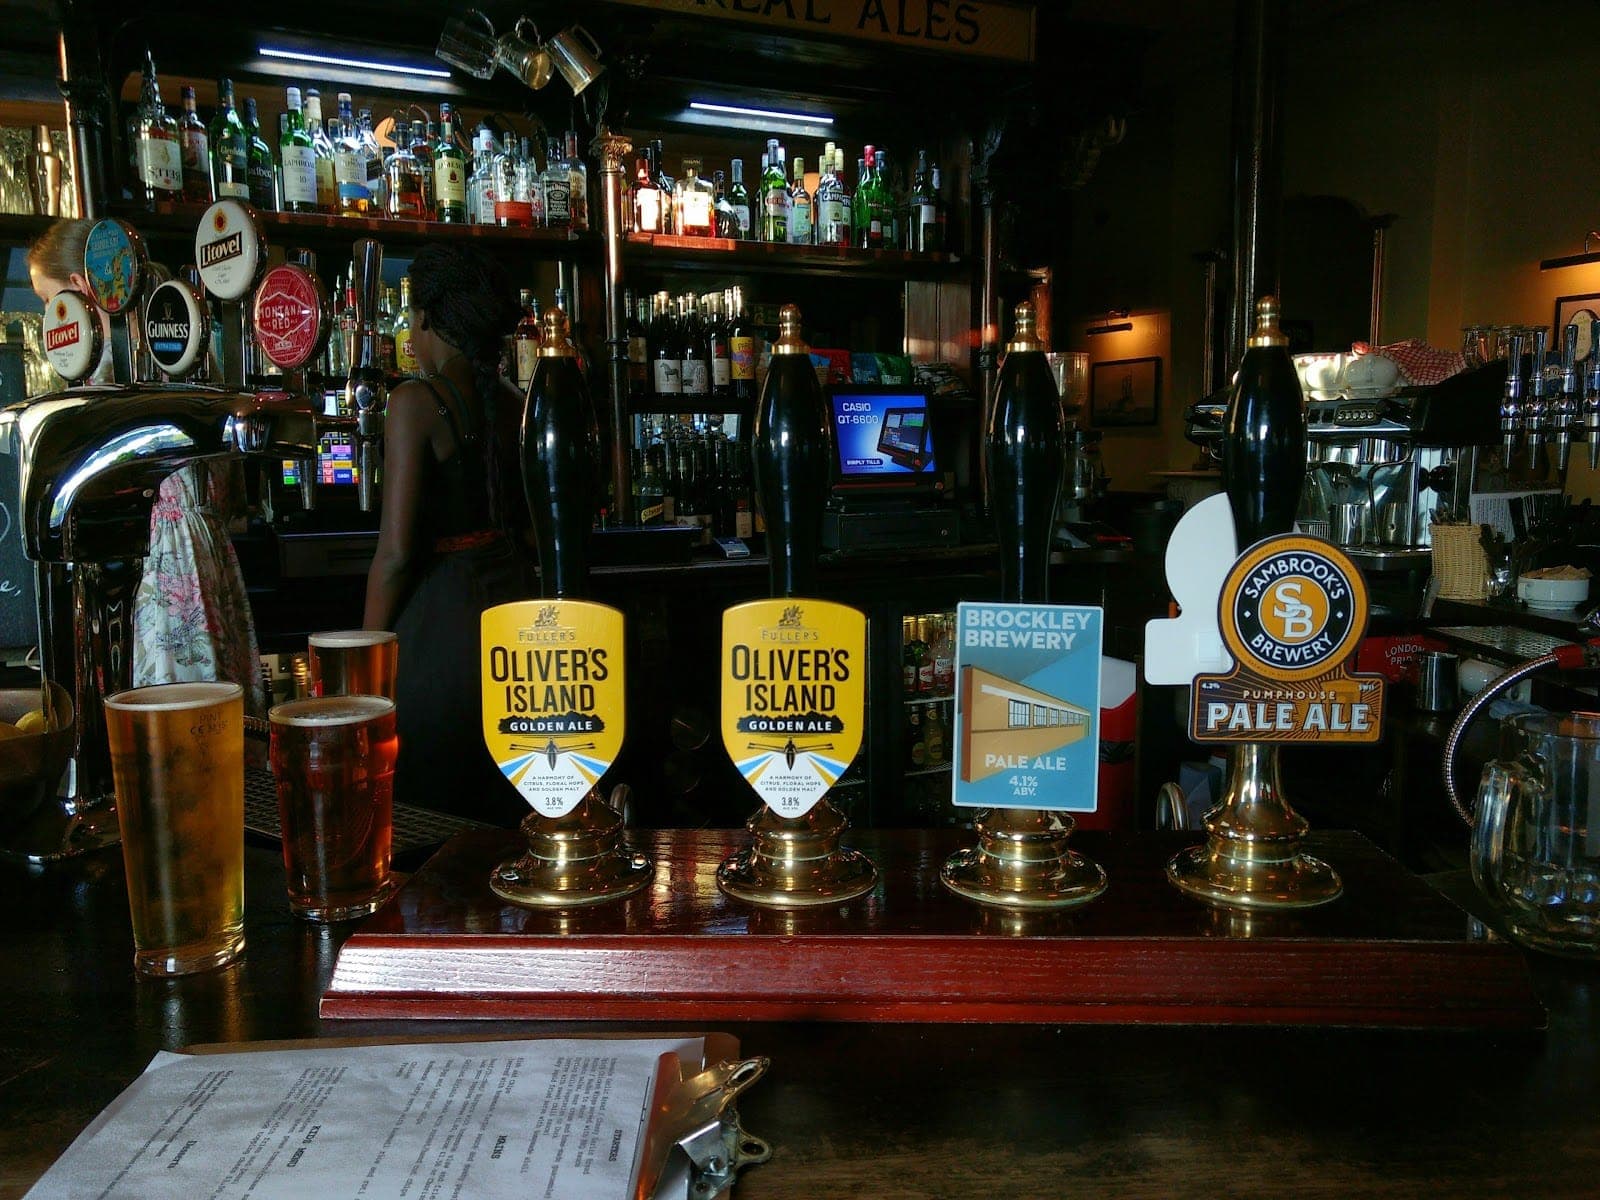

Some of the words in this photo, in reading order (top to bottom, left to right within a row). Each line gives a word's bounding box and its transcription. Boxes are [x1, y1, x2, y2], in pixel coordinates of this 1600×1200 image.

[857, 0, 981, 46] ALES
[201, 232, 241, 267] Litovel
[148, 320, 188, 338] GUINNESS
[271, 318, 291, 331] RED
[47, 322, 78, 350] Litovel
[842, 402, 871, 412] CASIO
[838, 415, 879, 425] QT-6600
[1245, 557, 1345, 599] SAMBROOK'S
[965, 609, 1091, 630] BROCKLEY
[964, 629, 1077, 650] BREWERY
[1251, 631, 1333, 662] BREWERY
[490, 646, 609, 683] OLIVER'S
[731, 644, 851, 683] OLIVER'S
[505, 684, 595, 713] ISLAND
[746, 684, 836, 712] ISLAND
[1243, 689, 1336, 700] PUMPHOUSE
[510, 721, 564, 732] GOLDEN
[568, 720, 593, 731] ALE
[749, 720, 804, 731] GOLDEN
[808, 720, 832, 731] ALE
[1206, 702, 1295, 731] PALE
[1302, 702, 1370, 731] ALE
[985, 754, 1029, 770] PALE
[1032, 756, 1067, 771] ALE
[1009, 775, 1038, 787] 4.1%
[545, 797, 563, 806] 3.8%
[781, 797, 799, 806] 3.8%
[607, 1130, 622, 1161] STARTERS
